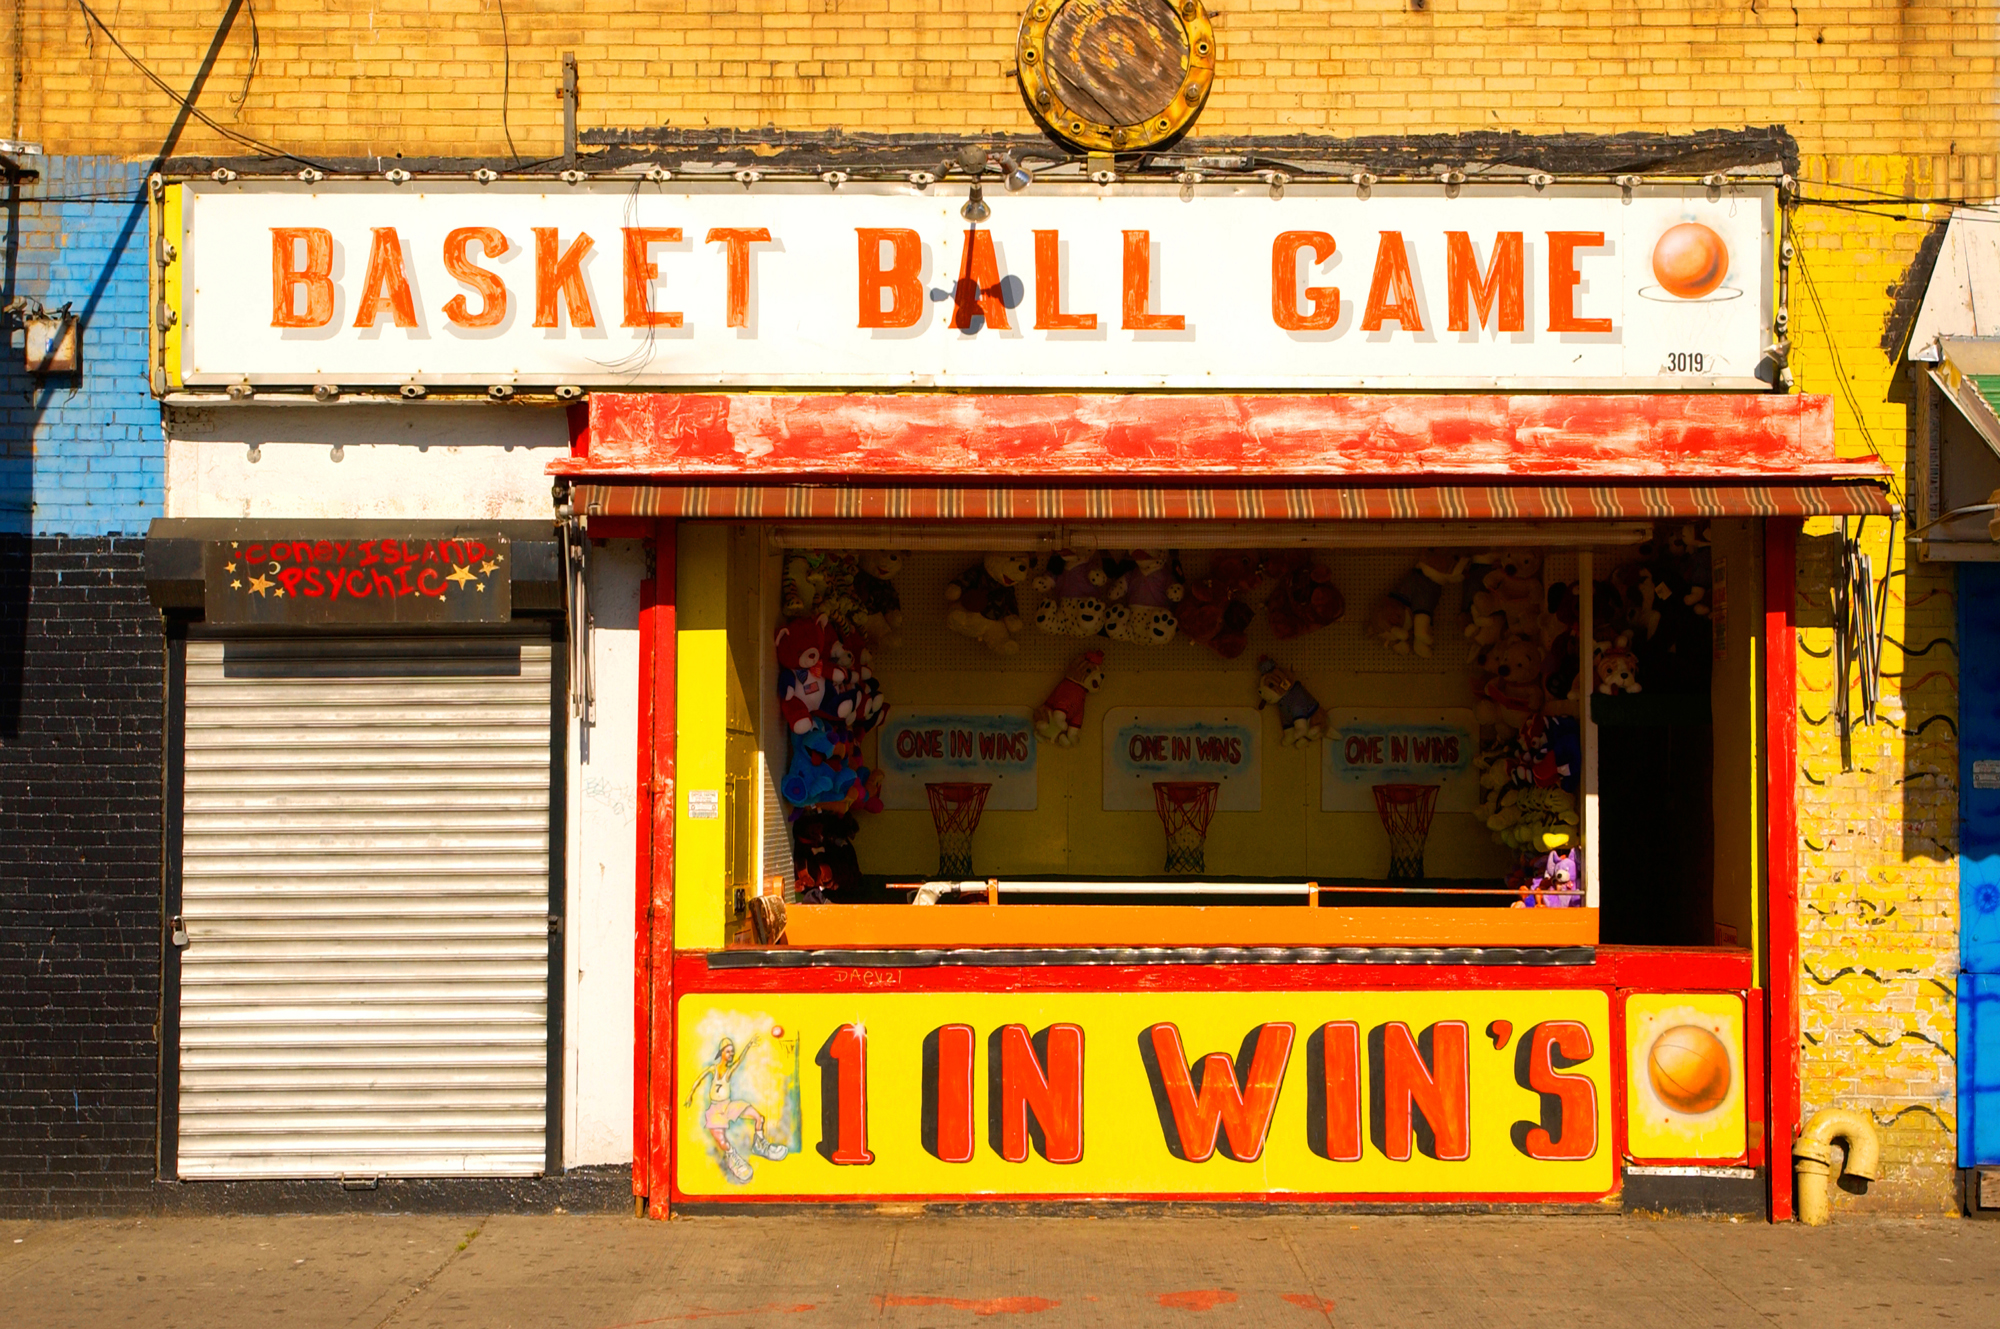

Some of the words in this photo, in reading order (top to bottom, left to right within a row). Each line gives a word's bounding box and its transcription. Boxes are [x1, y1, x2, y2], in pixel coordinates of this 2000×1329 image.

[268, 226, 773, 329] BASKET
[854, 227, 1187, 330] BALL
[1271, 230, 1614, 332] GAME
[1667, 352, 1704, 372] 3019
[896, 729, 944, 759] ONE
[950, 729, 973, 758] IN
[978, 731, 1029, 762] WINS
[1129, 734, 1169, 762] ONE
[1171, 735, 1192, 762] IN
[1195, 736, 1242, 765] WINS
[1344, 735, 1384, 764] ONE
[1390, 735, 1409, 763] IN
[1412, 735, 1460, 764] WINS
[715, 1083, 723, 1094] 7
[814, 1022, 875, 1166] 1
[920, 1022, 1085, 1165] IN
[1136, 1019, 1599, 1164] WIN'S
